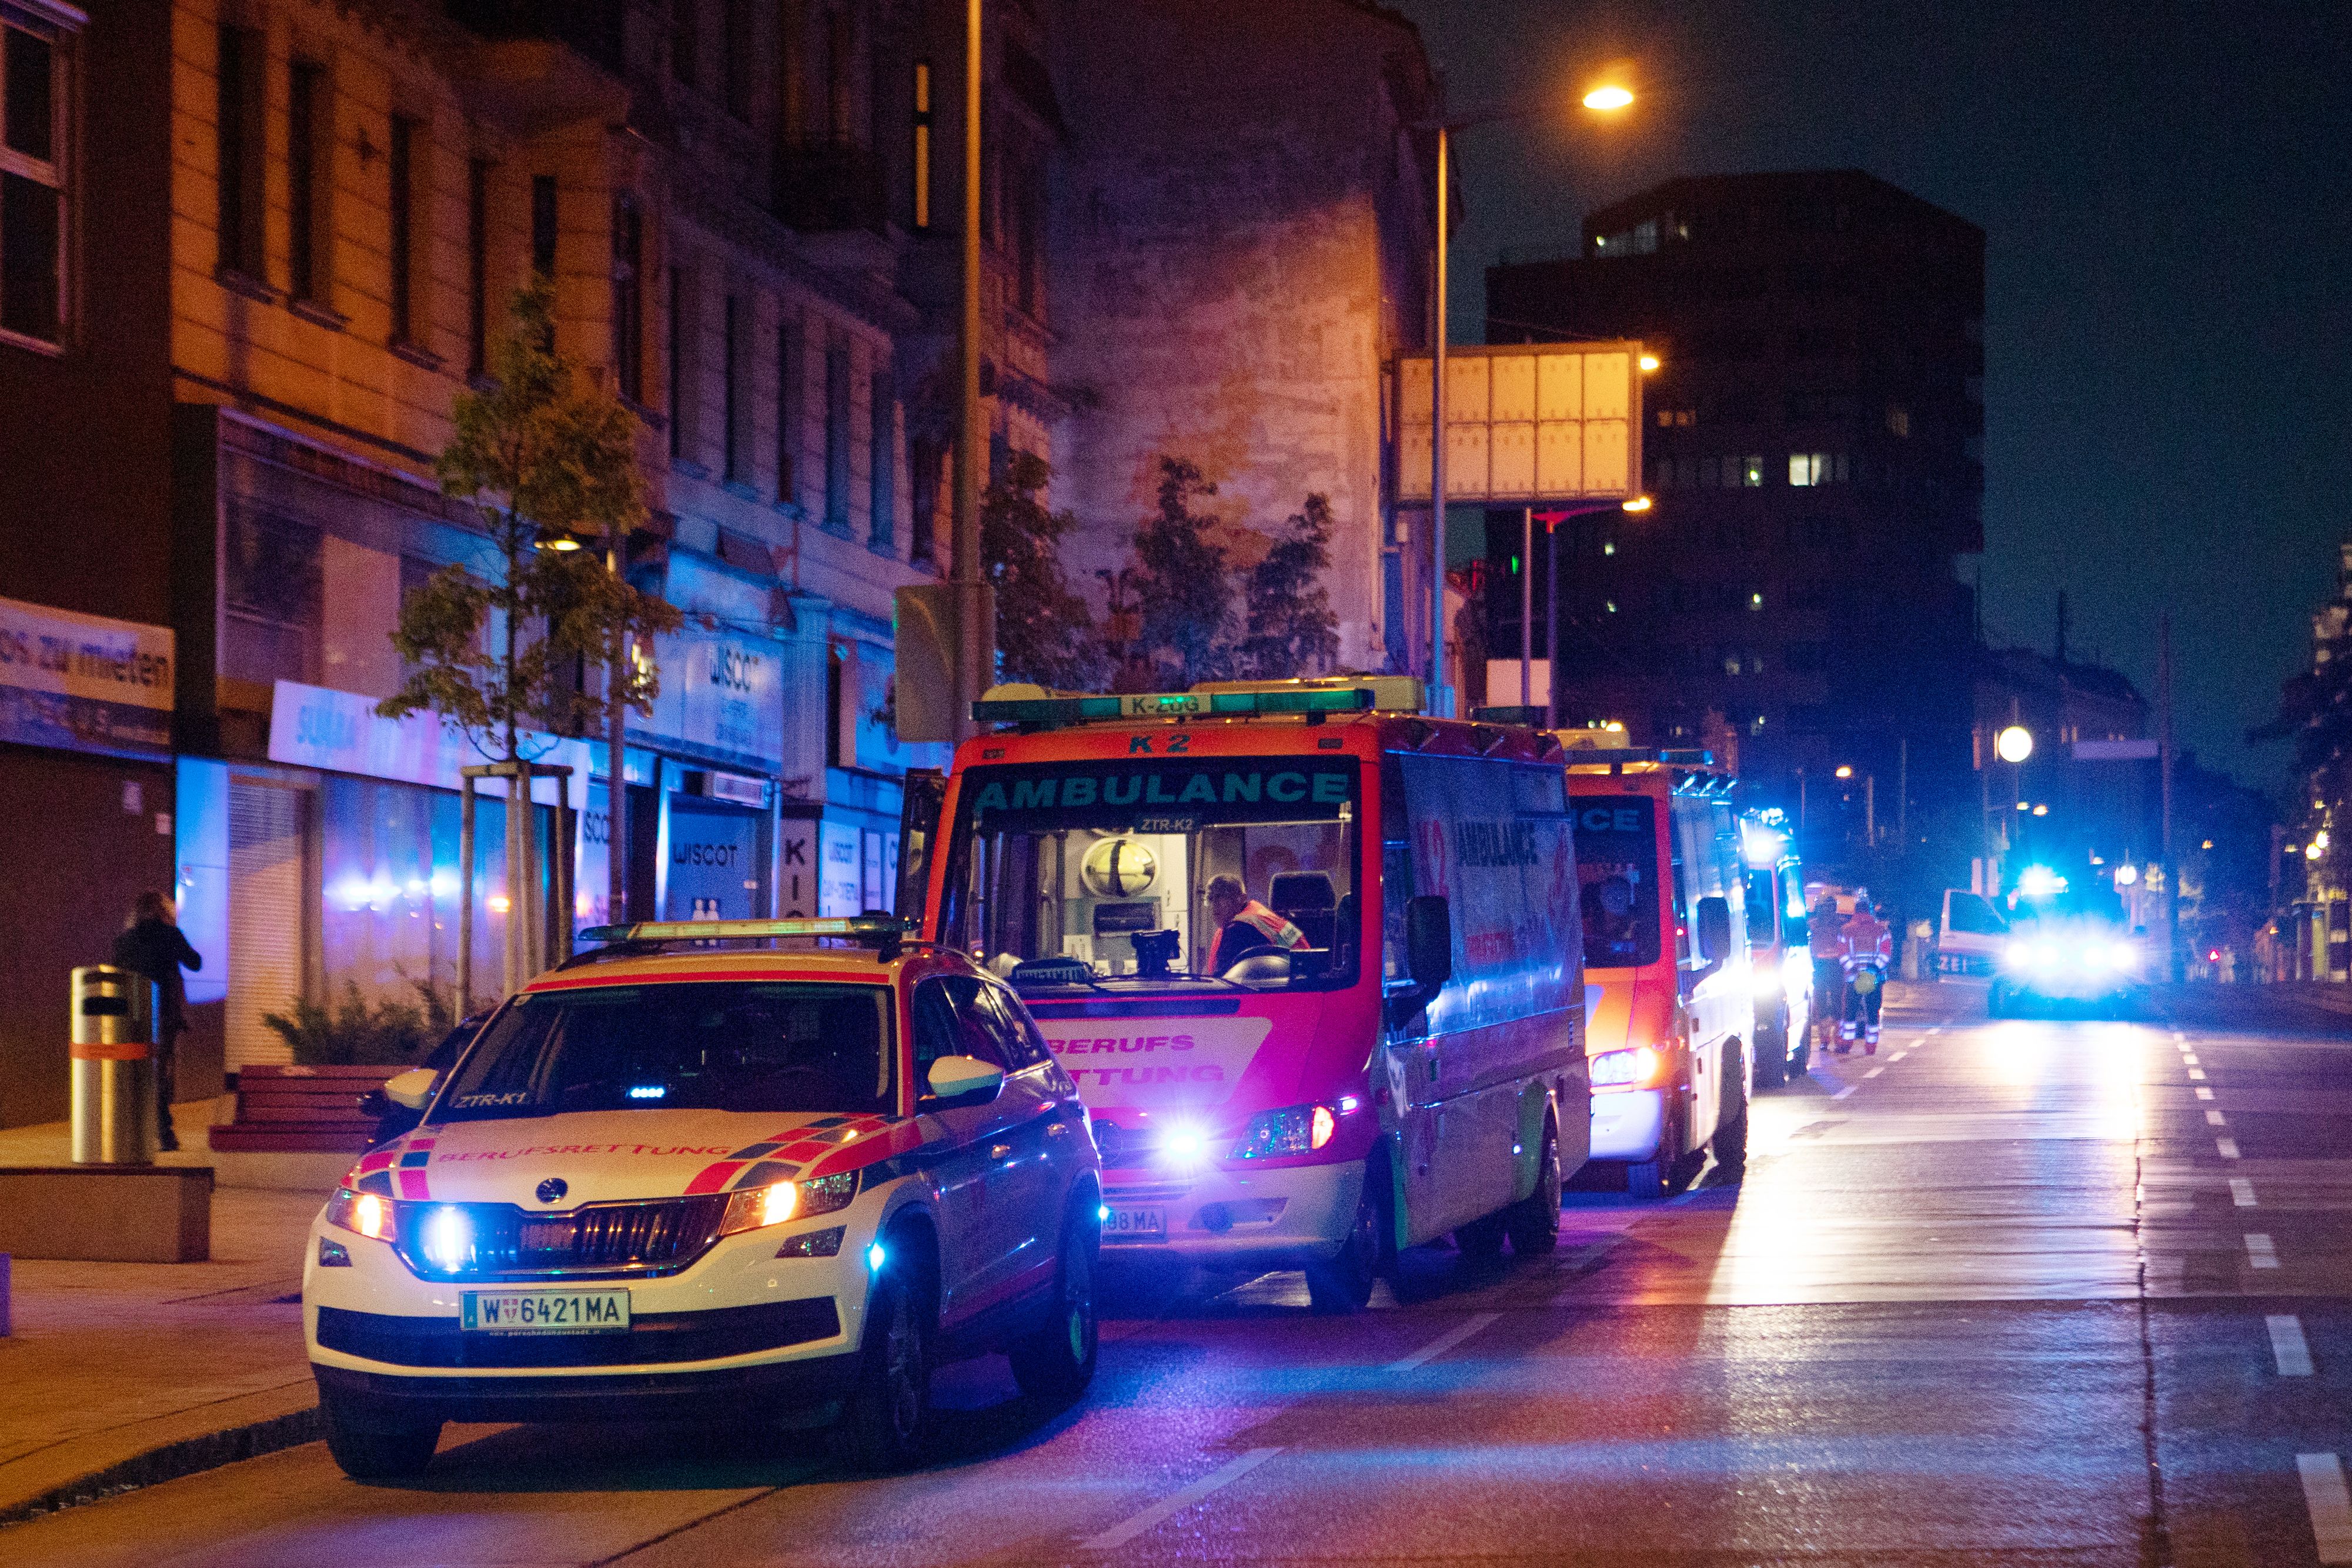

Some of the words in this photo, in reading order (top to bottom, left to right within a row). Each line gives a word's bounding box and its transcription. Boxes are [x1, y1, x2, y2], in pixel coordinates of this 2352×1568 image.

[1129, 737, 1153, 753] K
[1167, 735, 1190, 753] 2
[974, 773, 1349, 811] AMBULANCE
[1141, 818, 1194, 831] ZTR-K2
[674, 844, 737, 866] WISCOT
[1046, 1035, 1195, 1054] BERUFS
[456, 1092, 526, 1108] ZTR-K1
[438, 1144, 732, 1162] BERUFSRETTUNG
